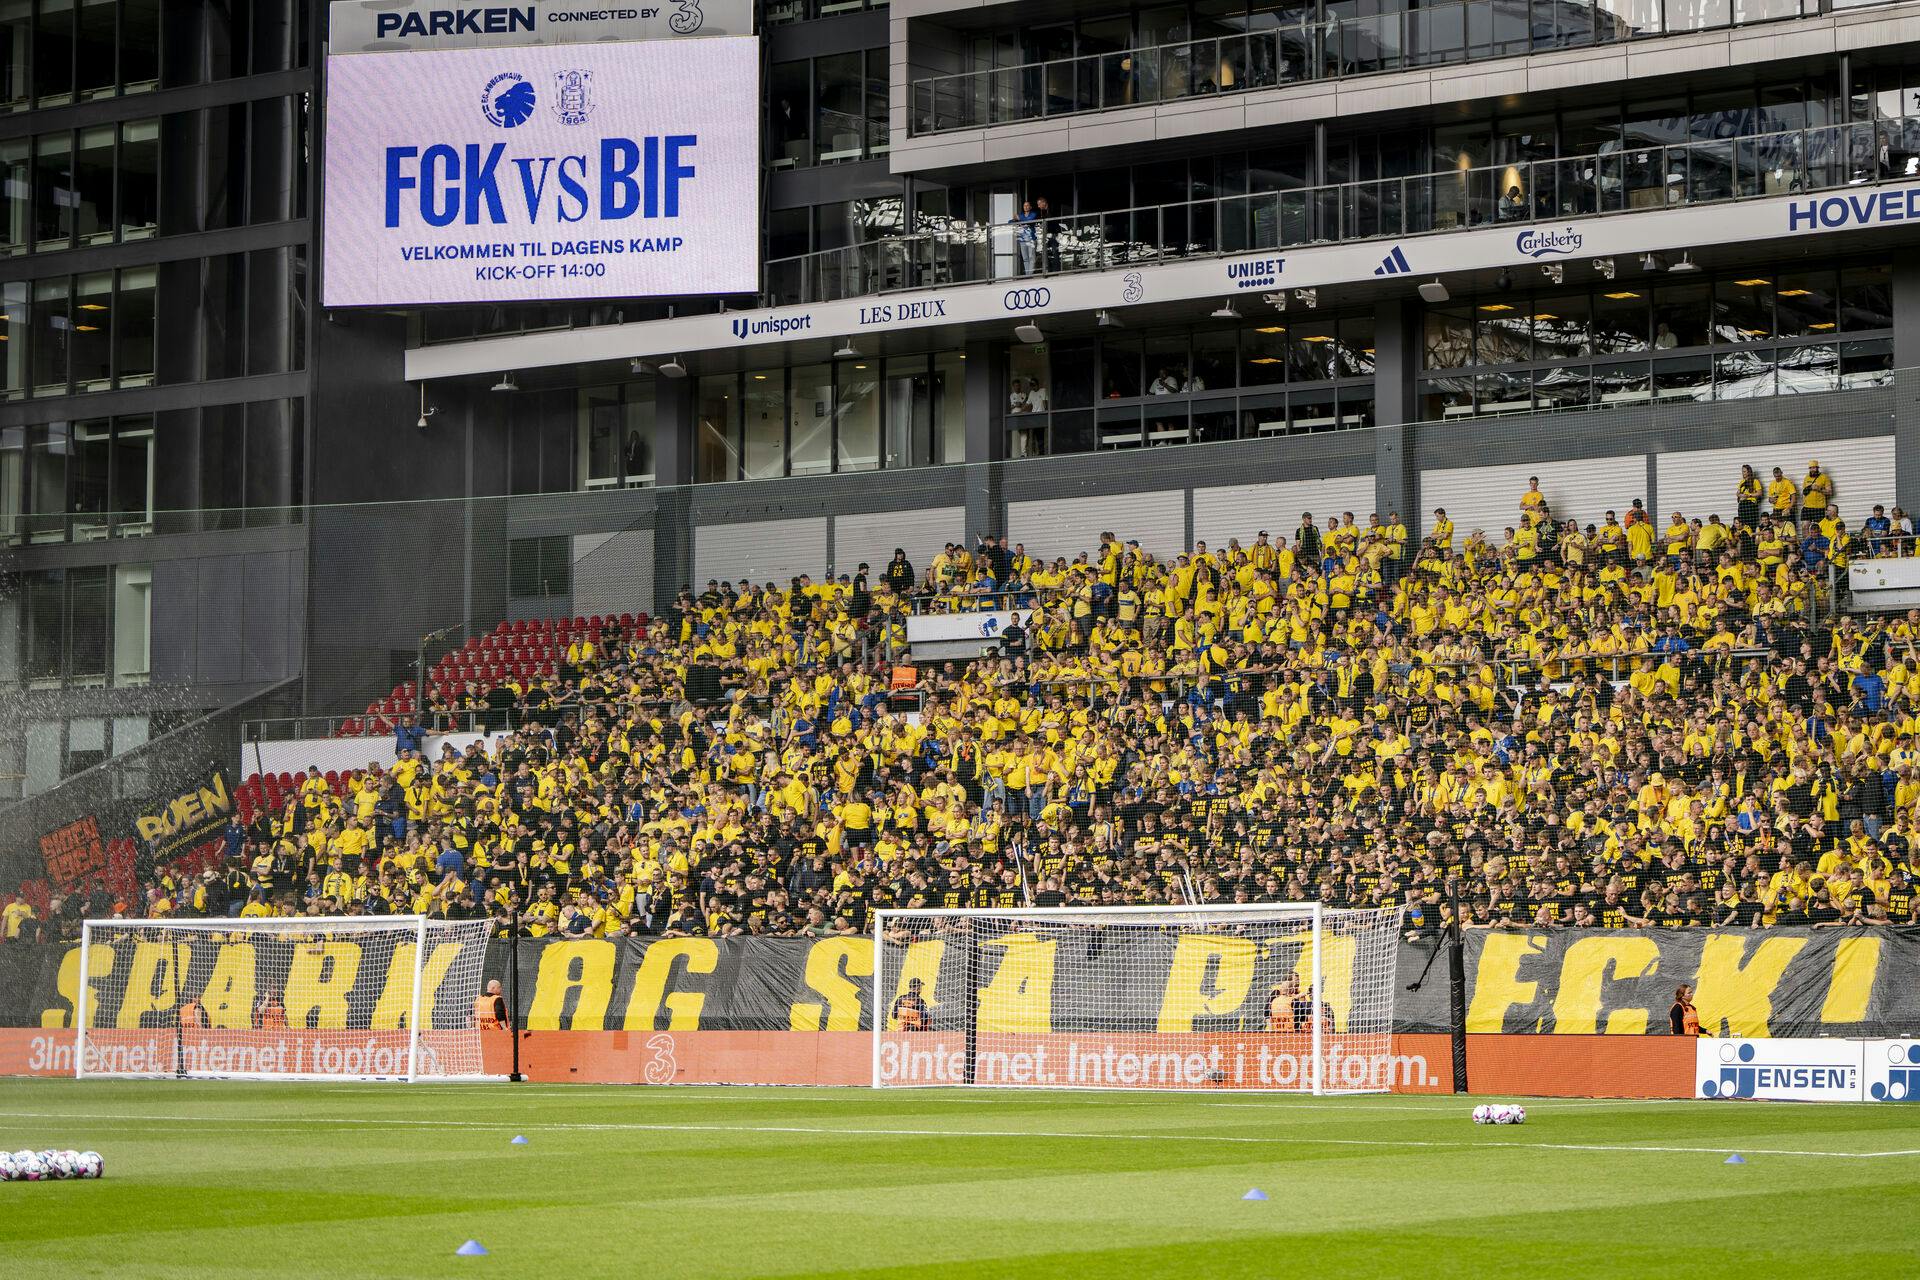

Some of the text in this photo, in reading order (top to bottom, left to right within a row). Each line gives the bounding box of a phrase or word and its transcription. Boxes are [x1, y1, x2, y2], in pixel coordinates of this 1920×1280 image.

[377, 7, 535, 38] PARKEN
[548, 8, 638, 23] CONNECTED
[641, 8, 660, 19] BY
[385, 142, 507, 228] FCK
[600, 134, 697, 221] BIF
[401, 237, 683, 262] VELKOMMEN TIL DAGENS KAMP
[1516, 227, 1582, 257] Carlsberg
[476, 262, 606, 280] KICK-OFF 14:00
[1228, 258, 1285, 279] UNIBET
[751, 313, 811, 336] unisport
[860, 299, 946, 325] LES DEUX
[41, 942, 463, 1031] SPARK
[294, 1037, 303, 1073] i
[645, 1033, 676, 1084] 3
[880, 1040, 1439, 1089] 3Internet. Internet i topform.
